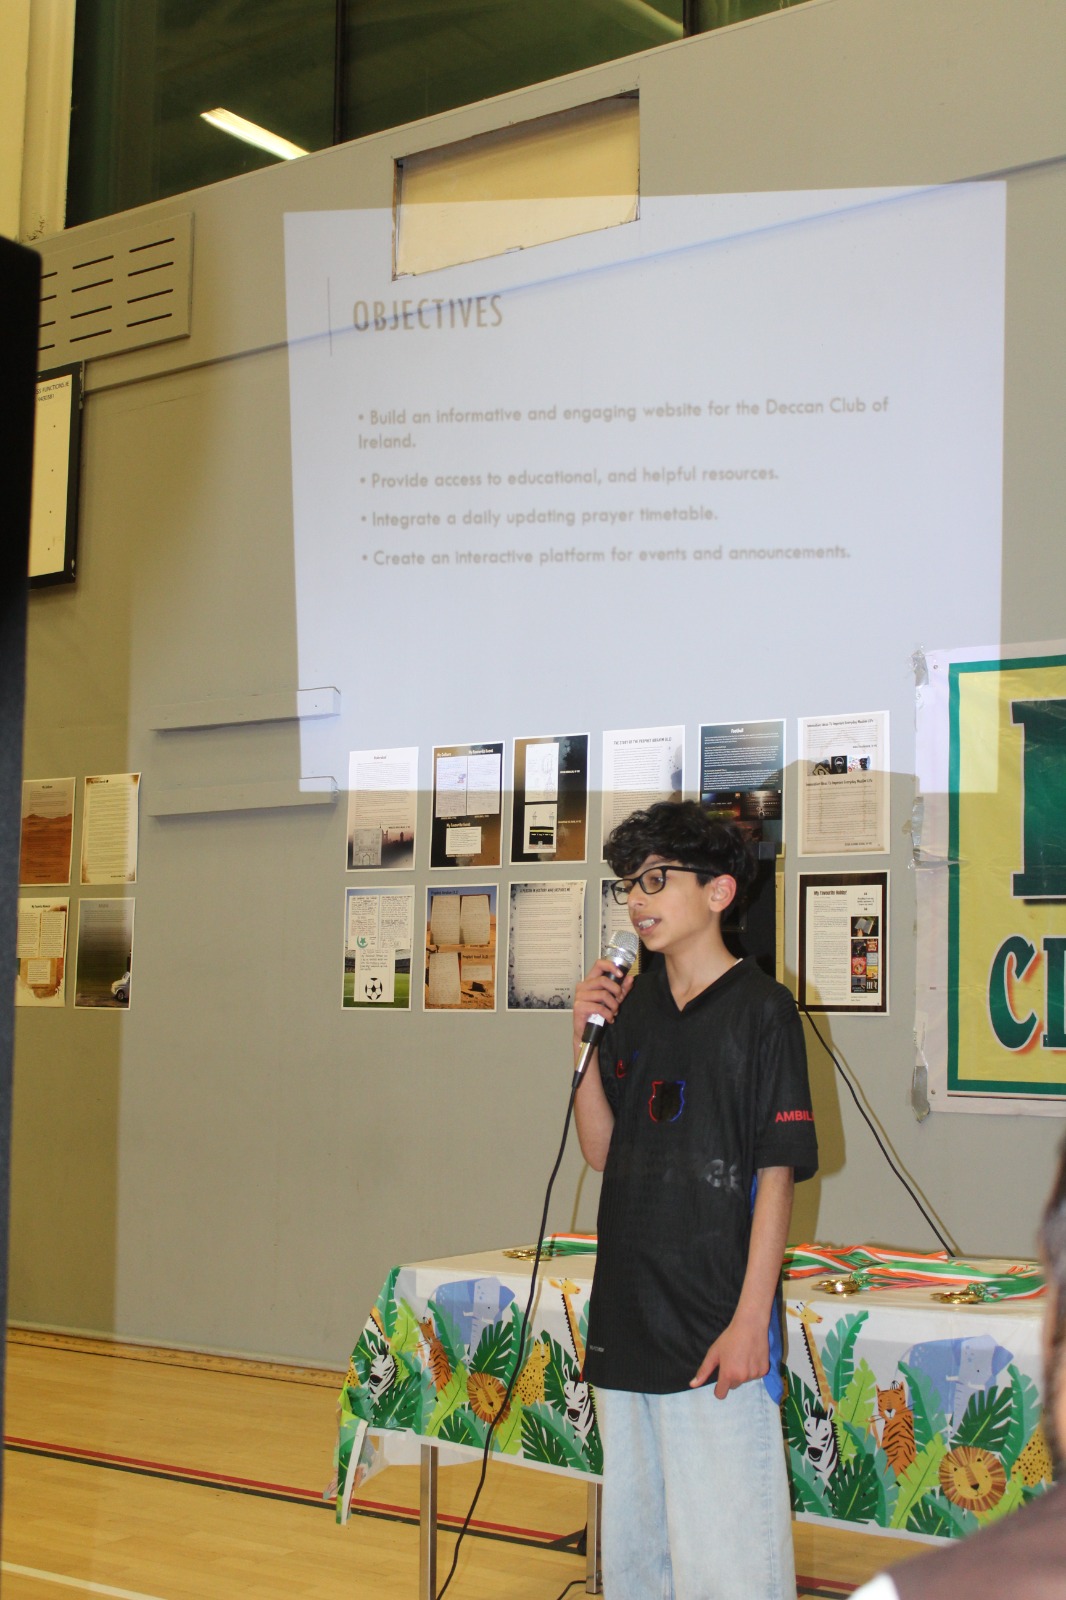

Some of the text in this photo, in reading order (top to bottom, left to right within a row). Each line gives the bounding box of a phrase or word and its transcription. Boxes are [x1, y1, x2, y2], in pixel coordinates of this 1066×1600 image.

[353, 294, 503, 332] OBJECTIVES
[370, 397, 866, 425] Build an informative and engaging website for the Deccan Club
[872, 396, 888, 412] of
[359, 433, 696, 488] Ireland. Provide access to educational, and helpful
[373, 469, 779, 530] resources. Integrate a daily updating prayer
[373, 505, 722, 566] timetable. Create an interactive platform for events and
